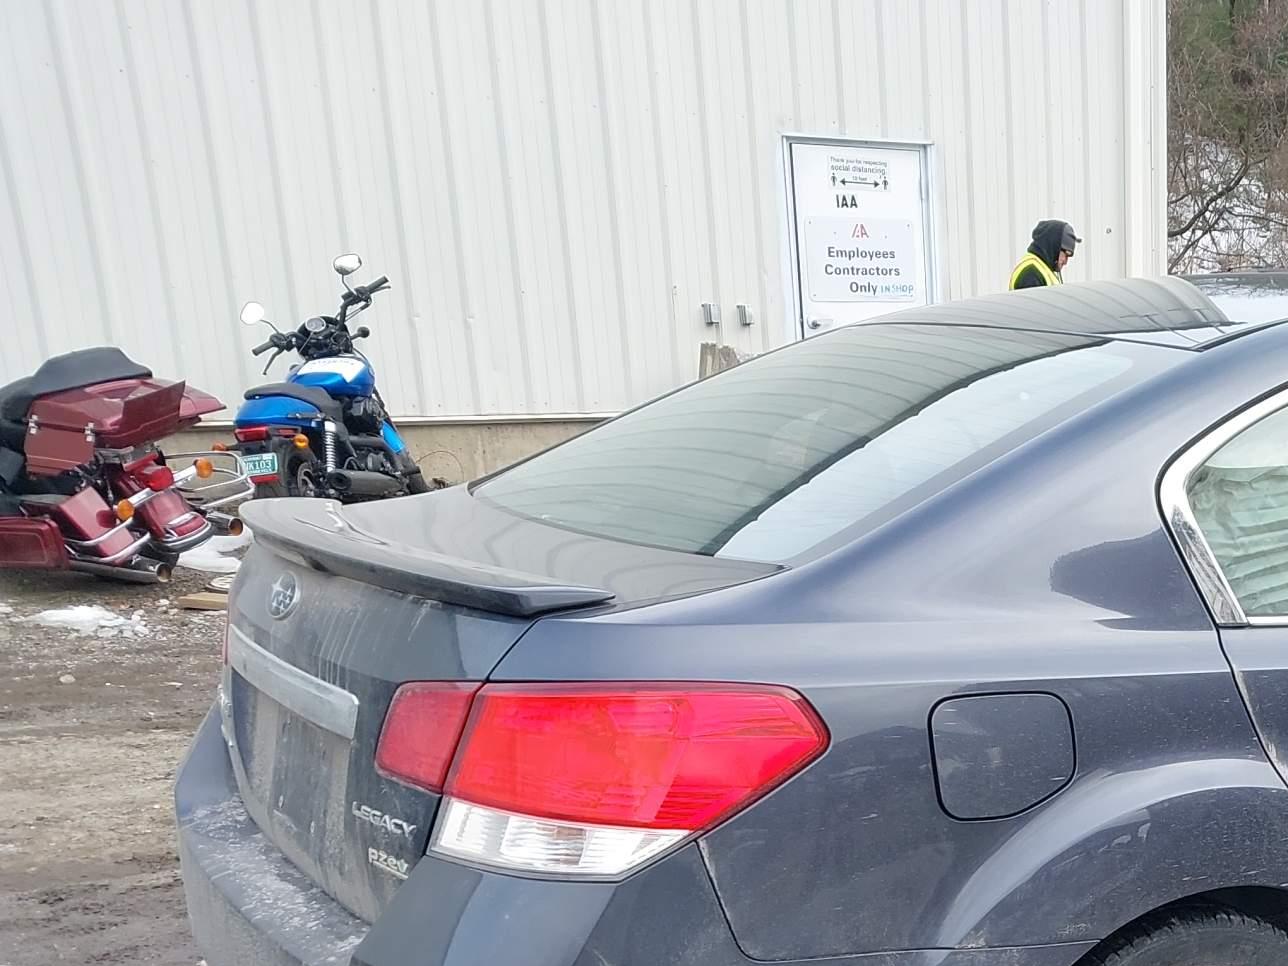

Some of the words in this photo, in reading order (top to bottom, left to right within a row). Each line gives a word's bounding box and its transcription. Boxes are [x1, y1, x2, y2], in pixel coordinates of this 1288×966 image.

[851, 165, 886, 176] distancing
[836, 194, 858, 208] IAA
[827, 246, 896, 261] Employees
[824, 263, 901, 276] Contractors
[849, 281, 878, 296] Only
[352, 801, 416, 838] LEGACY
